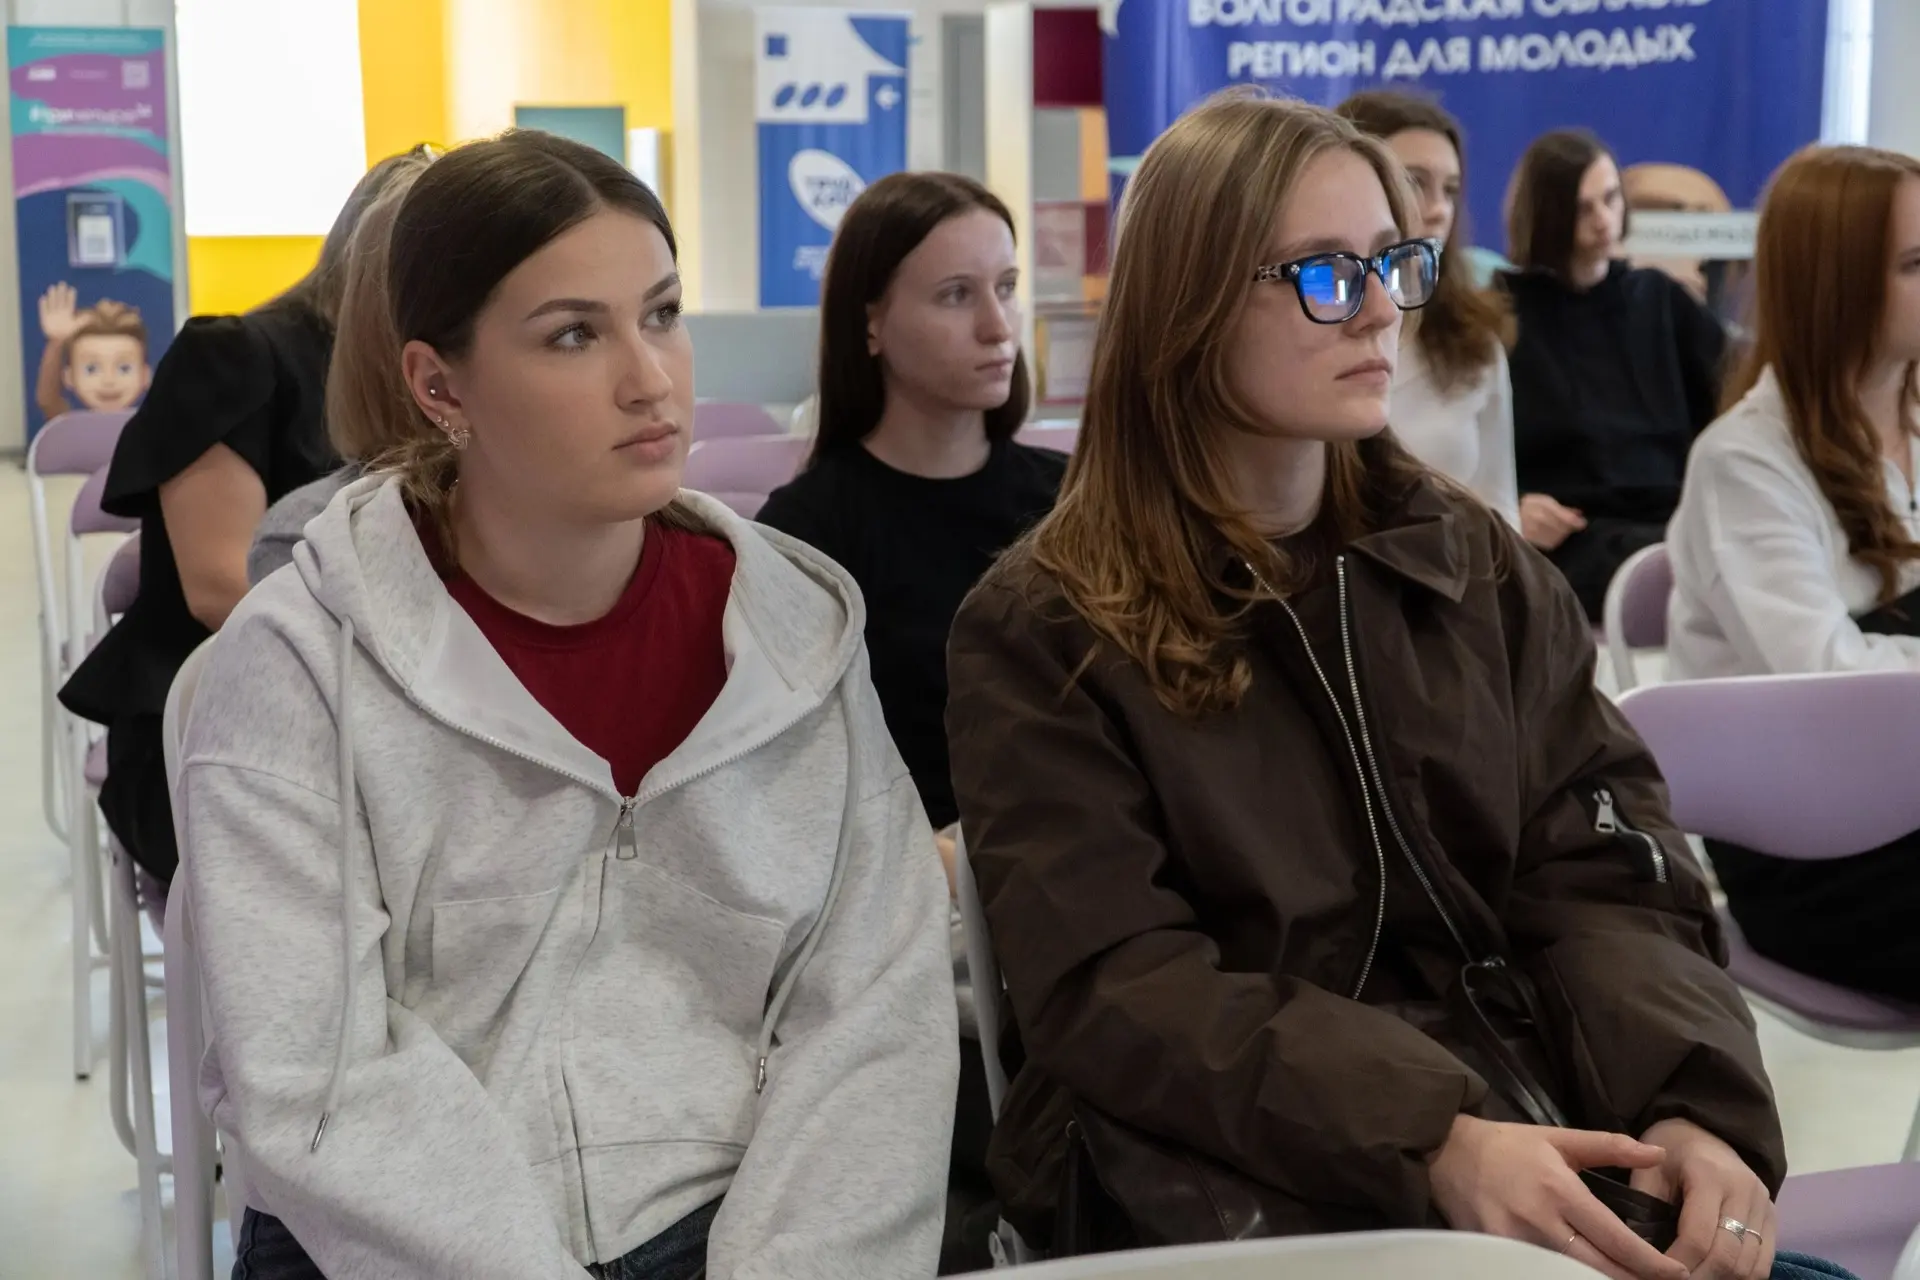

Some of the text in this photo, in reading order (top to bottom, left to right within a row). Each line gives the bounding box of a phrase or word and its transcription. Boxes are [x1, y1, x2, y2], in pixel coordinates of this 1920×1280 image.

[1228, 22, 1697, 81] РЕГИОН ДЛЯ МОЛОДЫХ
